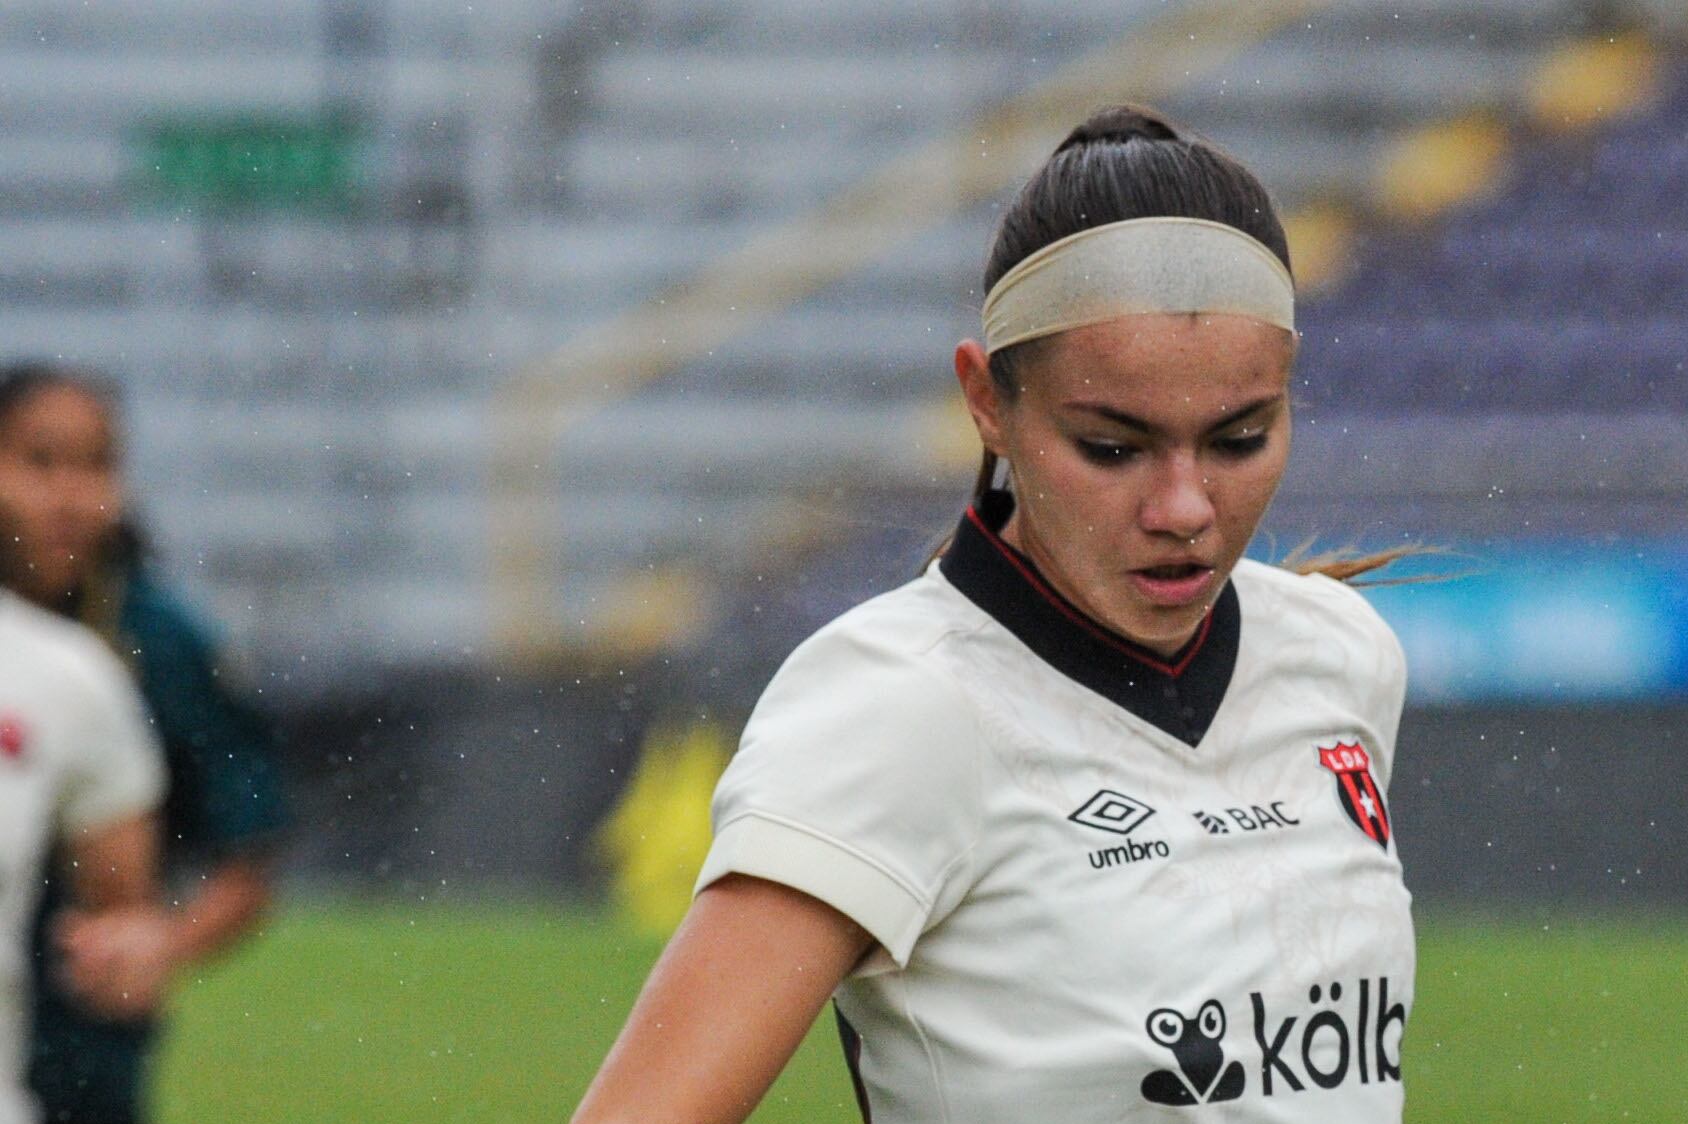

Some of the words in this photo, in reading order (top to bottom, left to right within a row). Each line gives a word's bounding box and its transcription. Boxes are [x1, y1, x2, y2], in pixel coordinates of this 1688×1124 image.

[1226, 801, 1300, 831] BAC
[1088, 838, 1169, 870] umbro
[1250, 976, 1405, 1096] kölb
